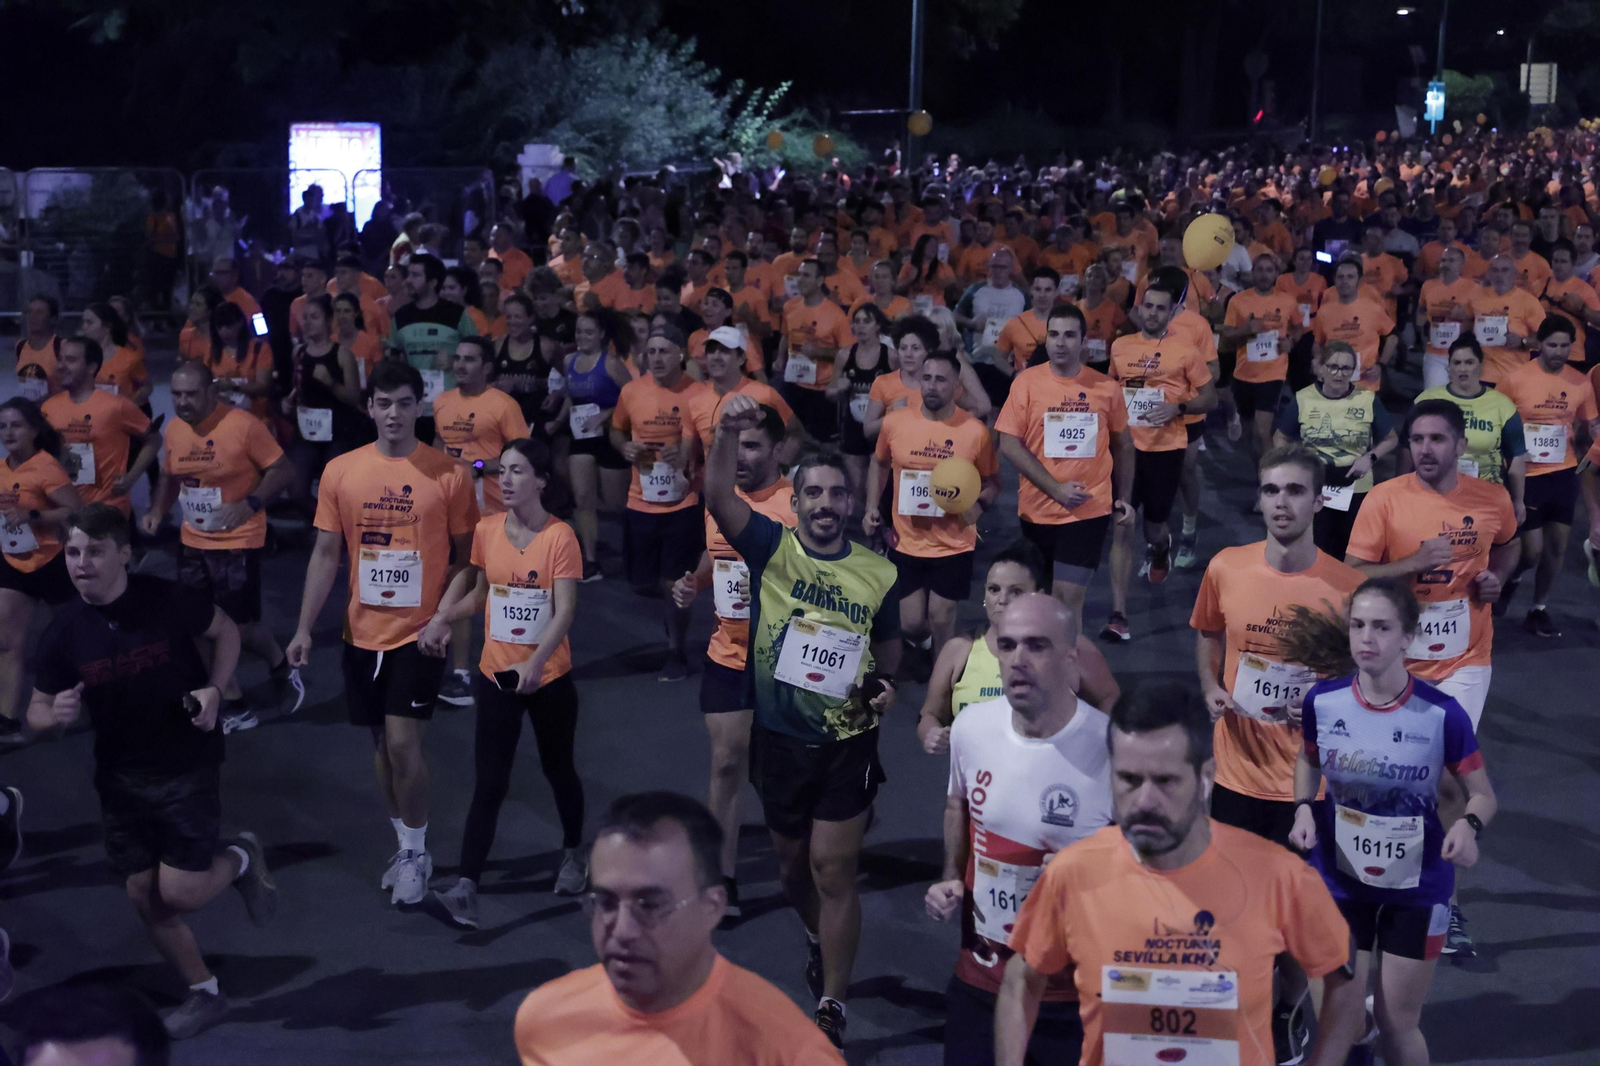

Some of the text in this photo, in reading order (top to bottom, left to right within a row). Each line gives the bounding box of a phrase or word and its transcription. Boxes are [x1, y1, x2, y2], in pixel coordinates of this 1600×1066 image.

[1059, 428, 1086, 440] 4925
[1533, 437, 1560, 448] 13883
[910, 486, 932, 498] 196
[186, 501, 214, 514] 11483
[363, 502, 413, 513] SEVILLA KH7
[380, 496, 414, 506] NOCTURNA
[370, 568, 409, 583] 21790
[727, 580, 740, 594] 34
[503, 605, 540, 621] 15327
[802, 644, 846, 670] 11061
[1322, 748, 1430, 781] Atletismo
[1353, 835, 1406, 859] 16115
[989, 888, 1028, 912] 161
[1144, 938, 1221, 949] NOCTURNA
[1114, 950, 1178, 964] SEVILLA
[1150, 1008, 1197, 1035] 802
